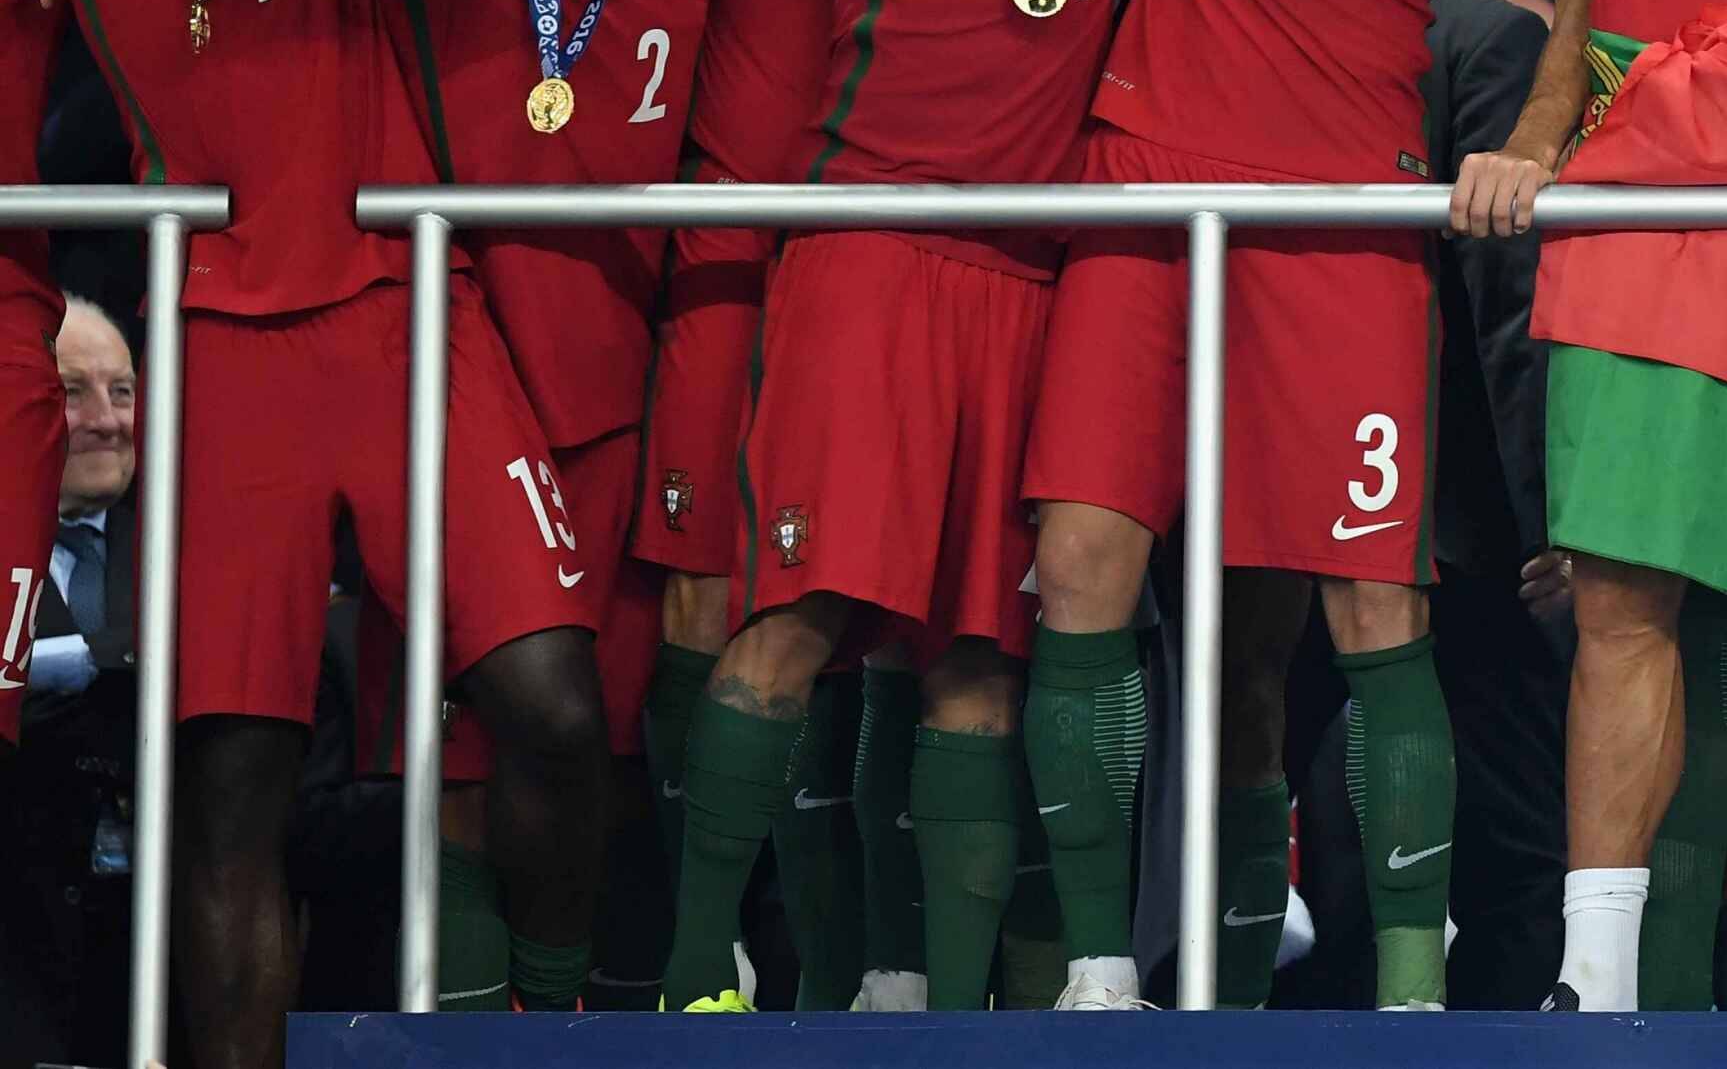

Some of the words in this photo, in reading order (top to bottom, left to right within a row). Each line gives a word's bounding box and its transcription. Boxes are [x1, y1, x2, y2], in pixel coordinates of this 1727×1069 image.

[566, 0, 601, 57] 2016
[627, 28, 671, 123] 2
[506, 457, 577, 550] 13
[1347, 413, 1400, 512] 3
